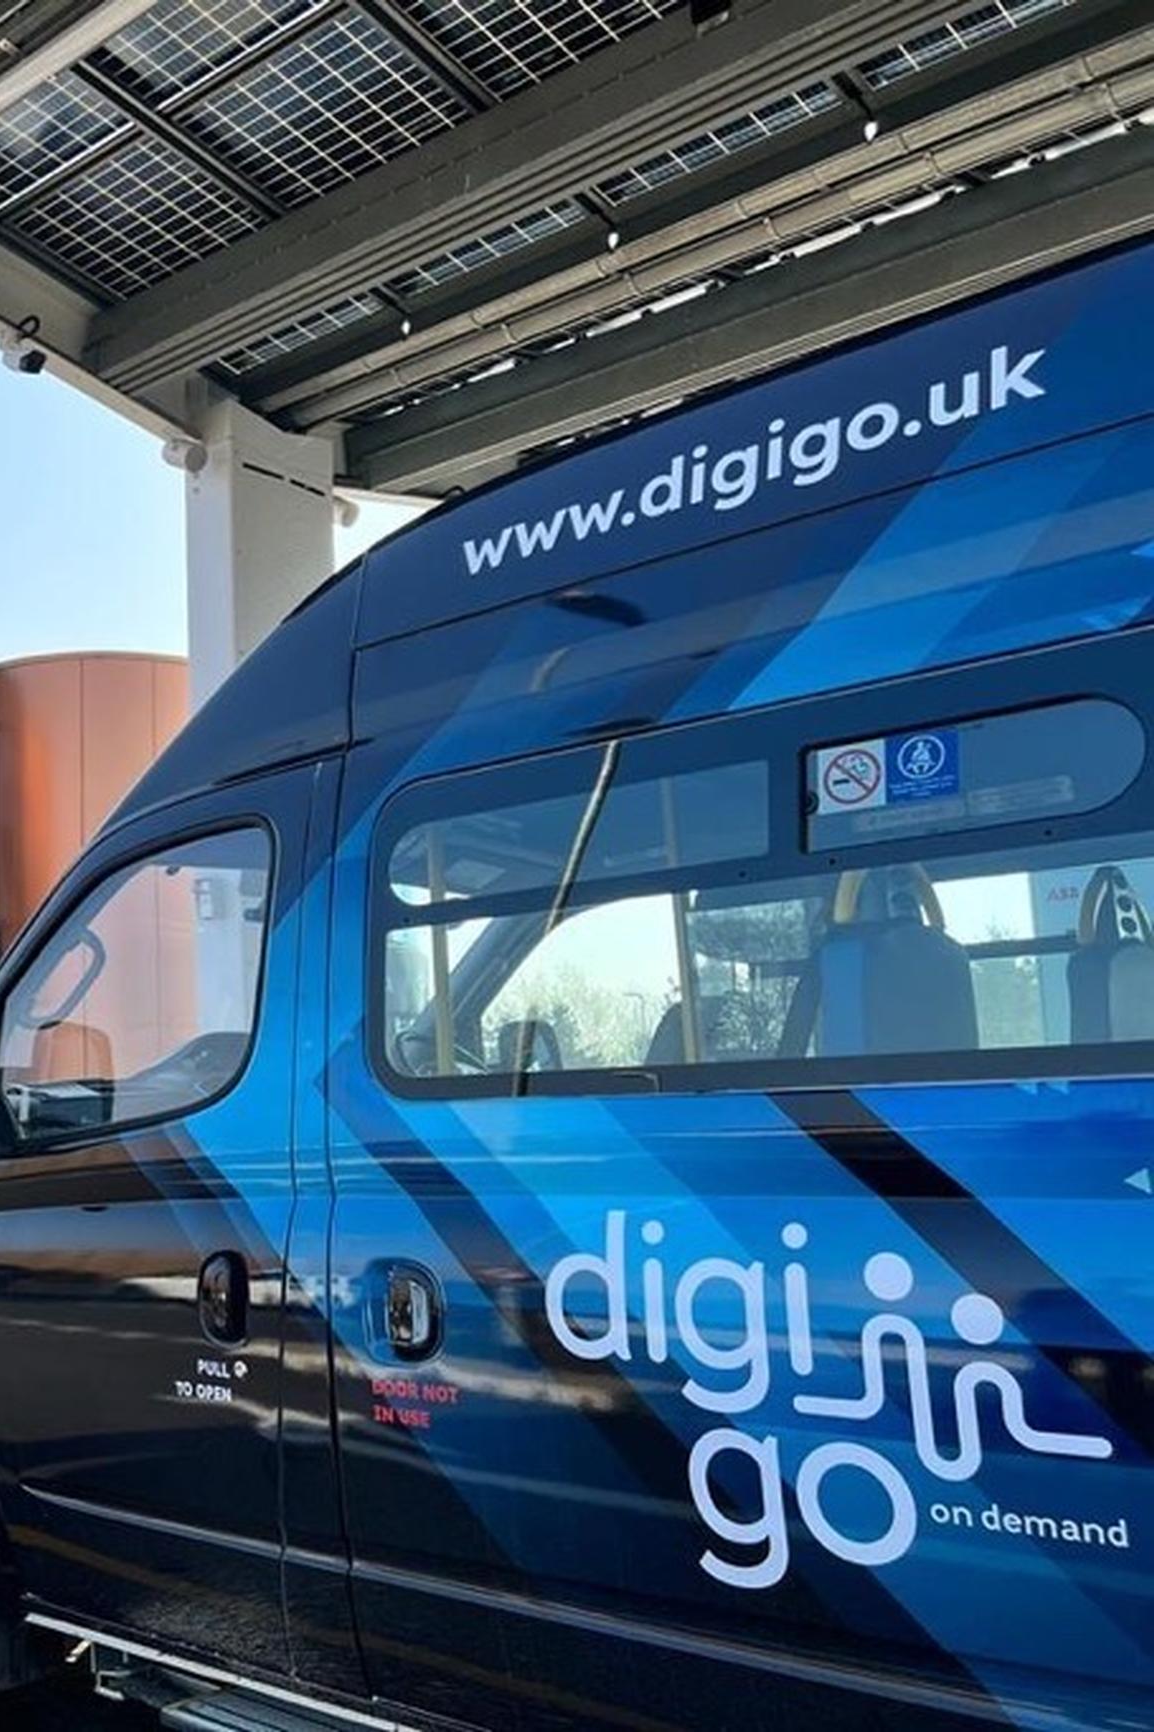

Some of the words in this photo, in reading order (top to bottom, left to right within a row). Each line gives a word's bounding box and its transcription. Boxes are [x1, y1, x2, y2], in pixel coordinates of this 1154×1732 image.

[462, 344, 1046, 575] www.digigo.uk
[545, 1209, 814, 1414] digi
[196, 1359, 231, 1379] PULL
[175, 1381, 193, 1397] TO
[195, 1384, 232, 1402] OPEN
[372, 1379, 419, 1400] DOOR
[423, 1384, 459, 1403] NOT
[373, 1404, 394, 1424] IN
[398, 1409, 431, 1429] USE
[688, 1427, 918, 1589] go
[930, 1503, 973, 1528] on
[980, 1505, 1130, 1549] demand
